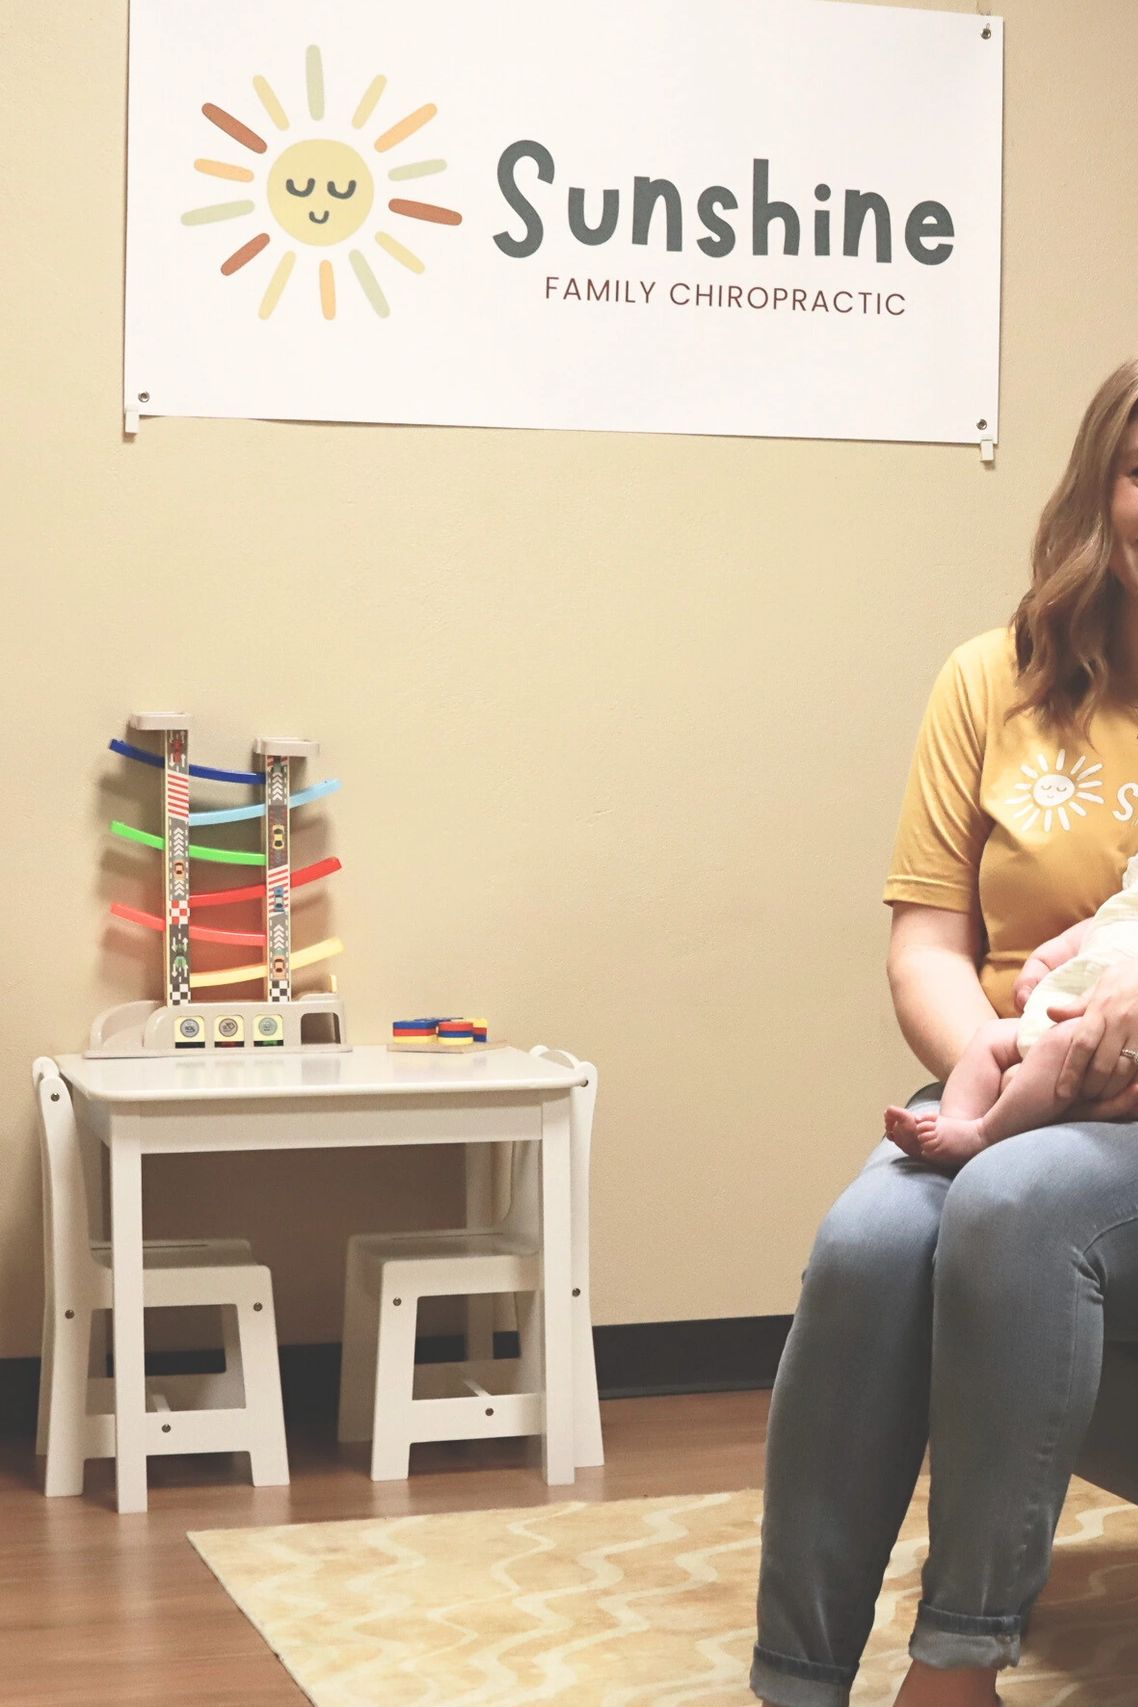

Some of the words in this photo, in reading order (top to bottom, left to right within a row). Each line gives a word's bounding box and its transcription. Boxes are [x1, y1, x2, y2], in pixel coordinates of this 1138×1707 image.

[493, 139, 955, 266] Sunshine
[545, 276, 656, 304] FAMILY
[669, 282, 906, 316] CHIROPRACTIC
